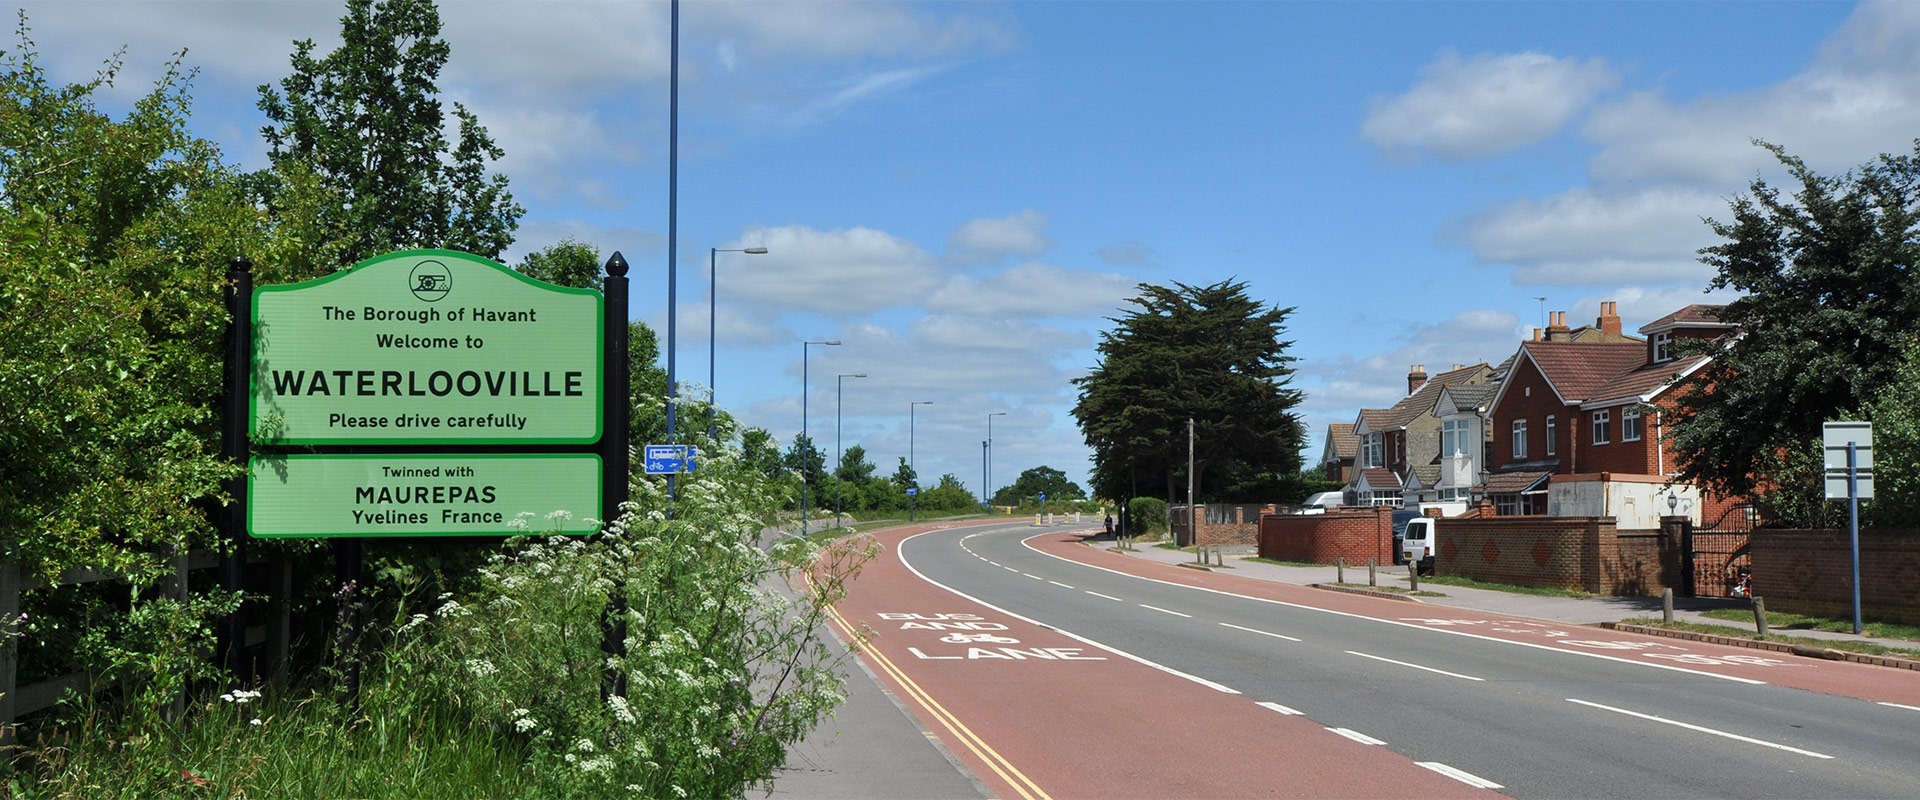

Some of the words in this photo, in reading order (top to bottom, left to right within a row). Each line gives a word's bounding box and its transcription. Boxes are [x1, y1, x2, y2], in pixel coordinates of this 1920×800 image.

[323, 307, 355, 320] The
[364, 307, 439, 324] Borough
[447, 308, 465, 321] of
[473, 308, 536, 322] Havant
[377, 334, 458, 348] Welcome
[465, 335, 483, 348] to
[272, 370, 583, 396] WATERLOOVILLE
[330, 414, 388, 427] Please
[395, 414, 440, 427] drive
[447, 414, 526, 430] carefully
[382, 467, 439, 477] Twinned
[445, 467, 473, 477] with
[355, 486, 496, 504] MAUREPAS
[352, 510, 428, 524] Yvelines
[443, 510, 502, 523] France
[877, 612, 985, 620] BUS
[900, 622, 1008, 630] AND
[908, 647, 1108, 660] LANE
